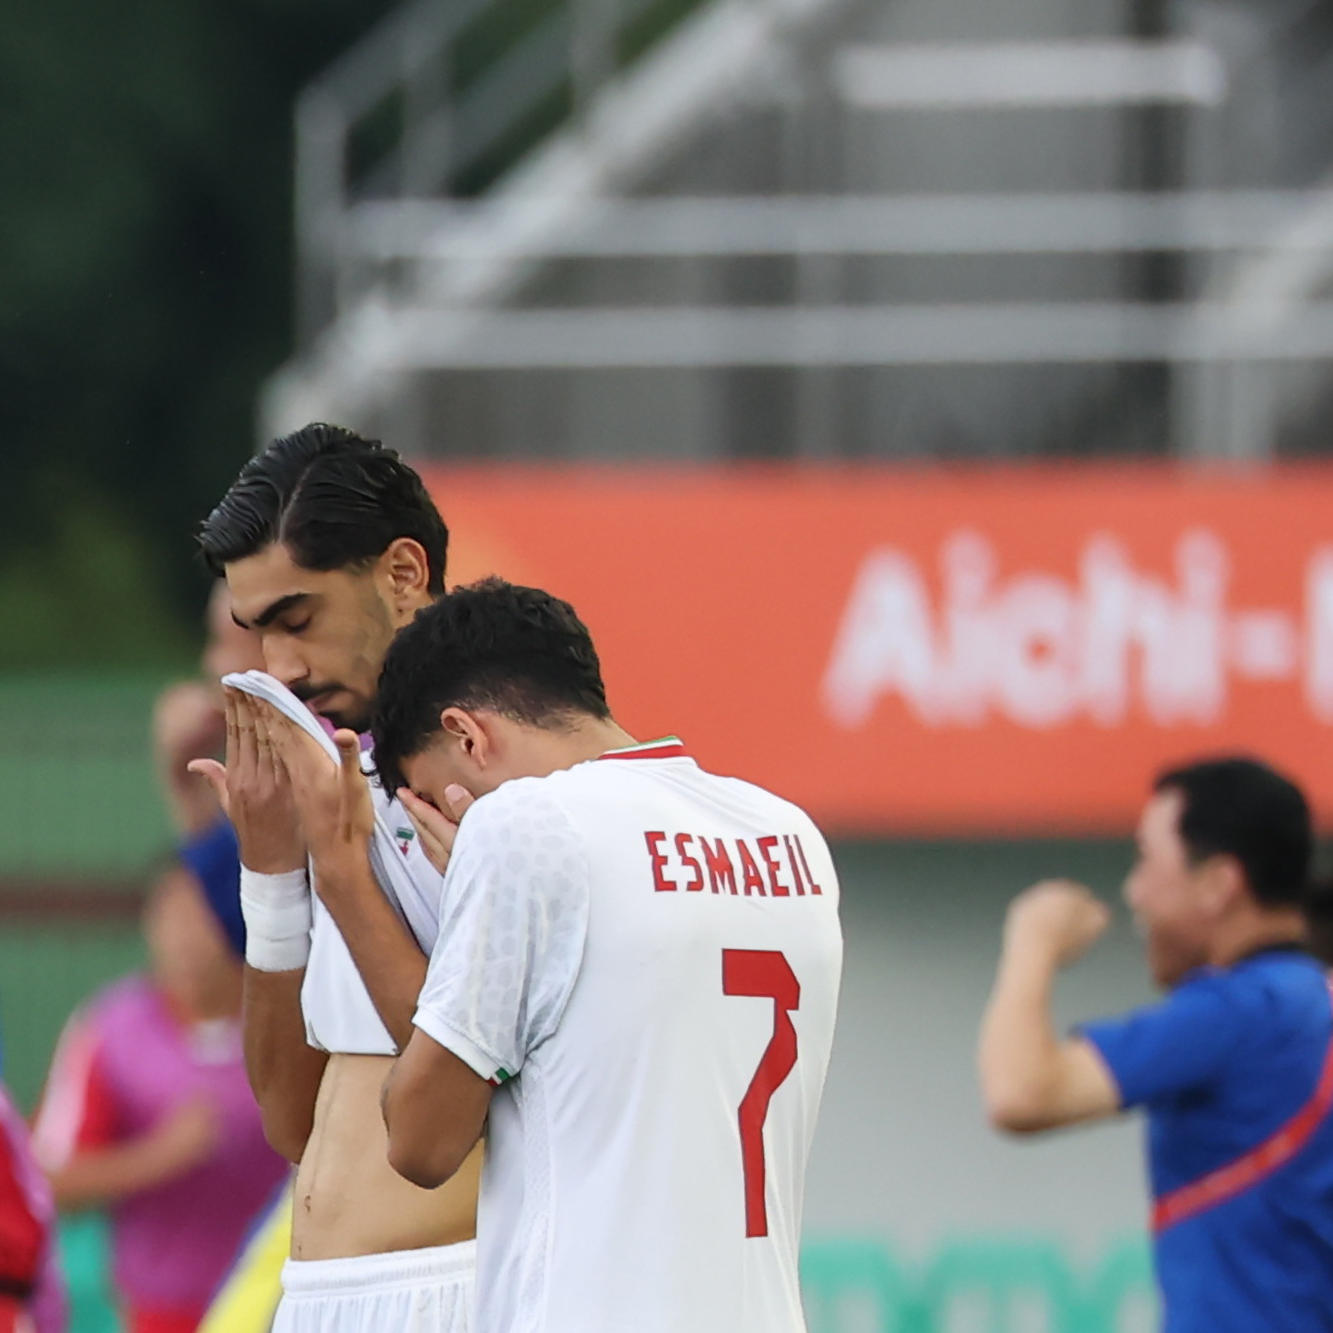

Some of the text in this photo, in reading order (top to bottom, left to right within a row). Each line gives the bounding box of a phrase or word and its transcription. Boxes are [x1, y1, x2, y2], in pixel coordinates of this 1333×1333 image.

[820, 526, 1333, 730] Aichi-
[643, 830, 823, 898] ESMAEIL
[721, 947, 801, 1239] 7
